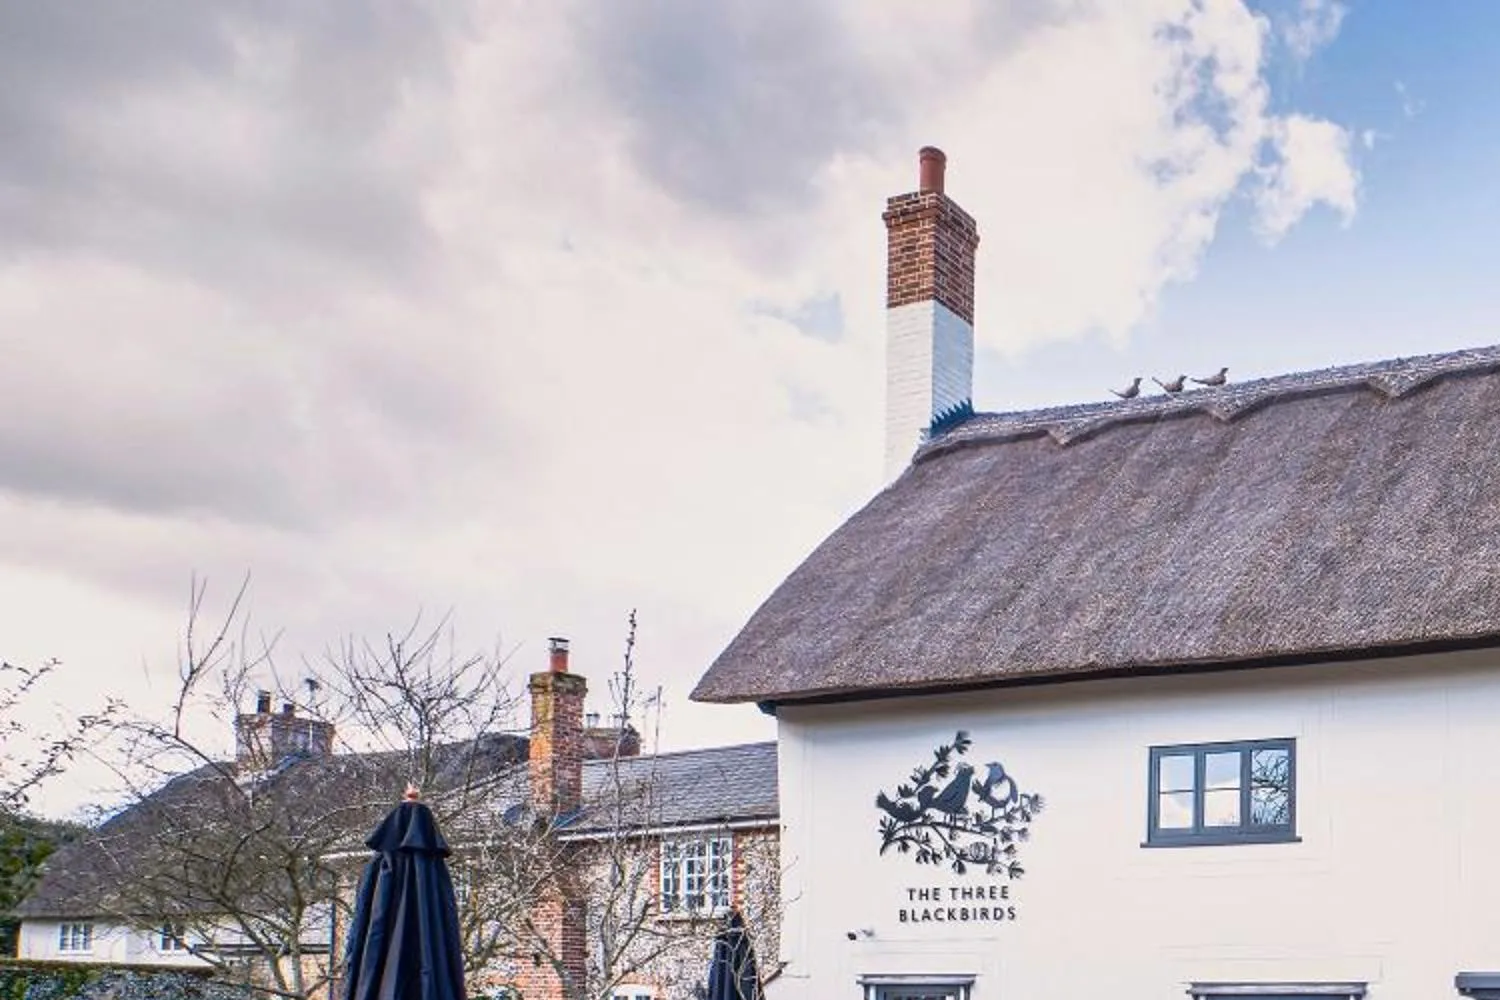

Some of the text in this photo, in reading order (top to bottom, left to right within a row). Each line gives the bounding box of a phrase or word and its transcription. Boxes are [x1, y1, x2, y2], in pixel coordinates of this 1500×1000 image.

[907, 885, 1009, 901] THE THREE
[899, 906, 1016, 923] BLACKBIRDS
